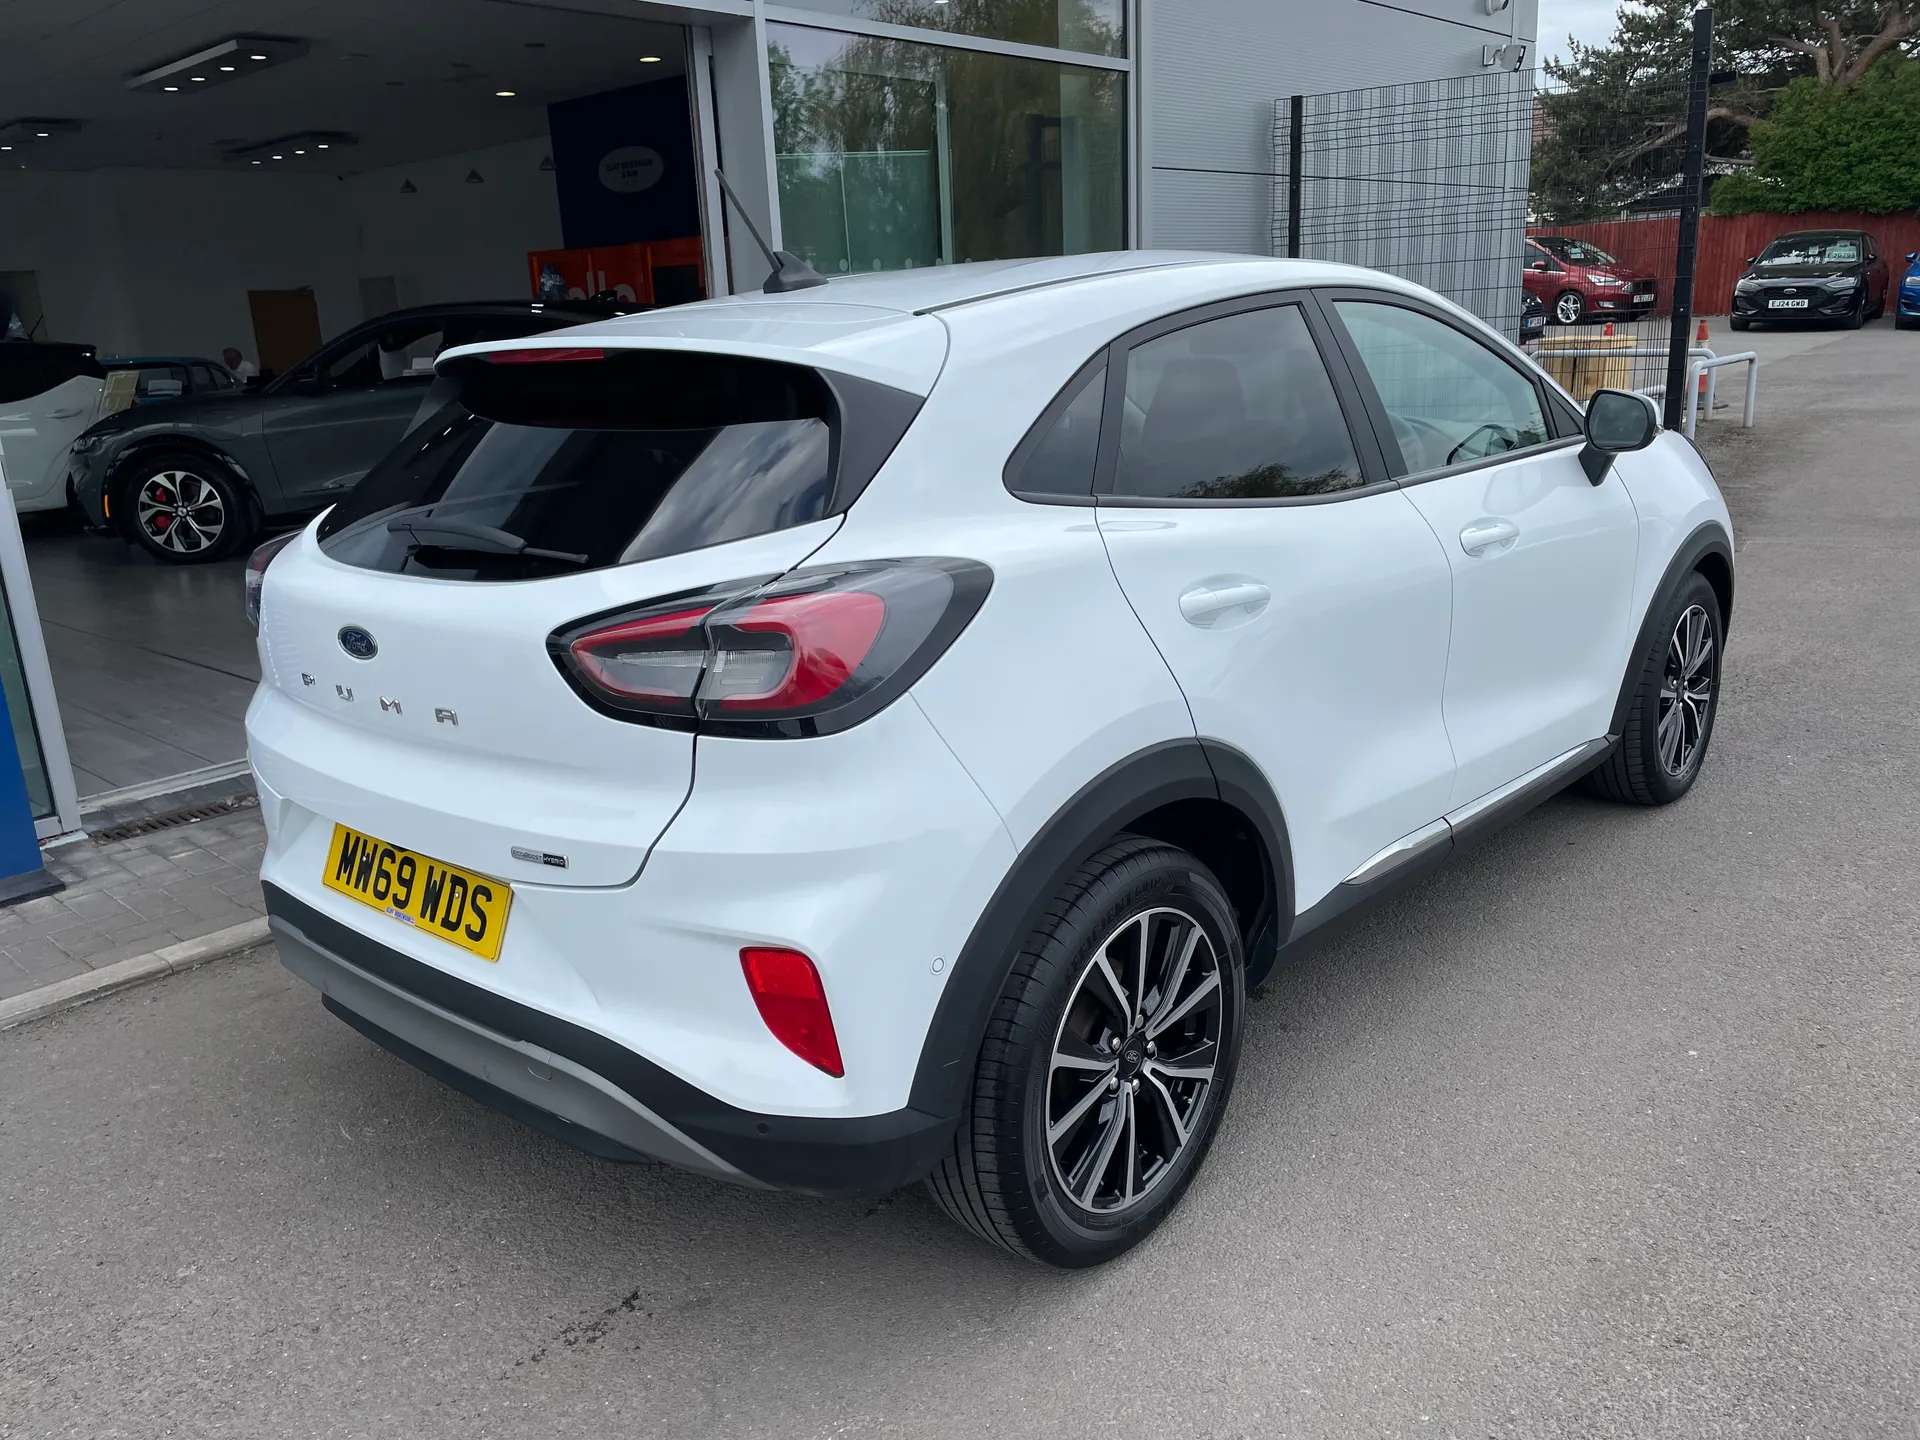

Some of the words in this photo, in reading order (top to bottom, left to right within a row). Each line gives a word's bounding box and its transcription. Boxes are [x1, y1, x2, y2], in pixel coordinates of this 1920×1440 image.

[1771, 300, 1790, 308] EJ24
[300, 671, 459, 727] PUMA
[335, 831, 417, 910] MW69
[419, 864, 493, 943] WDS
